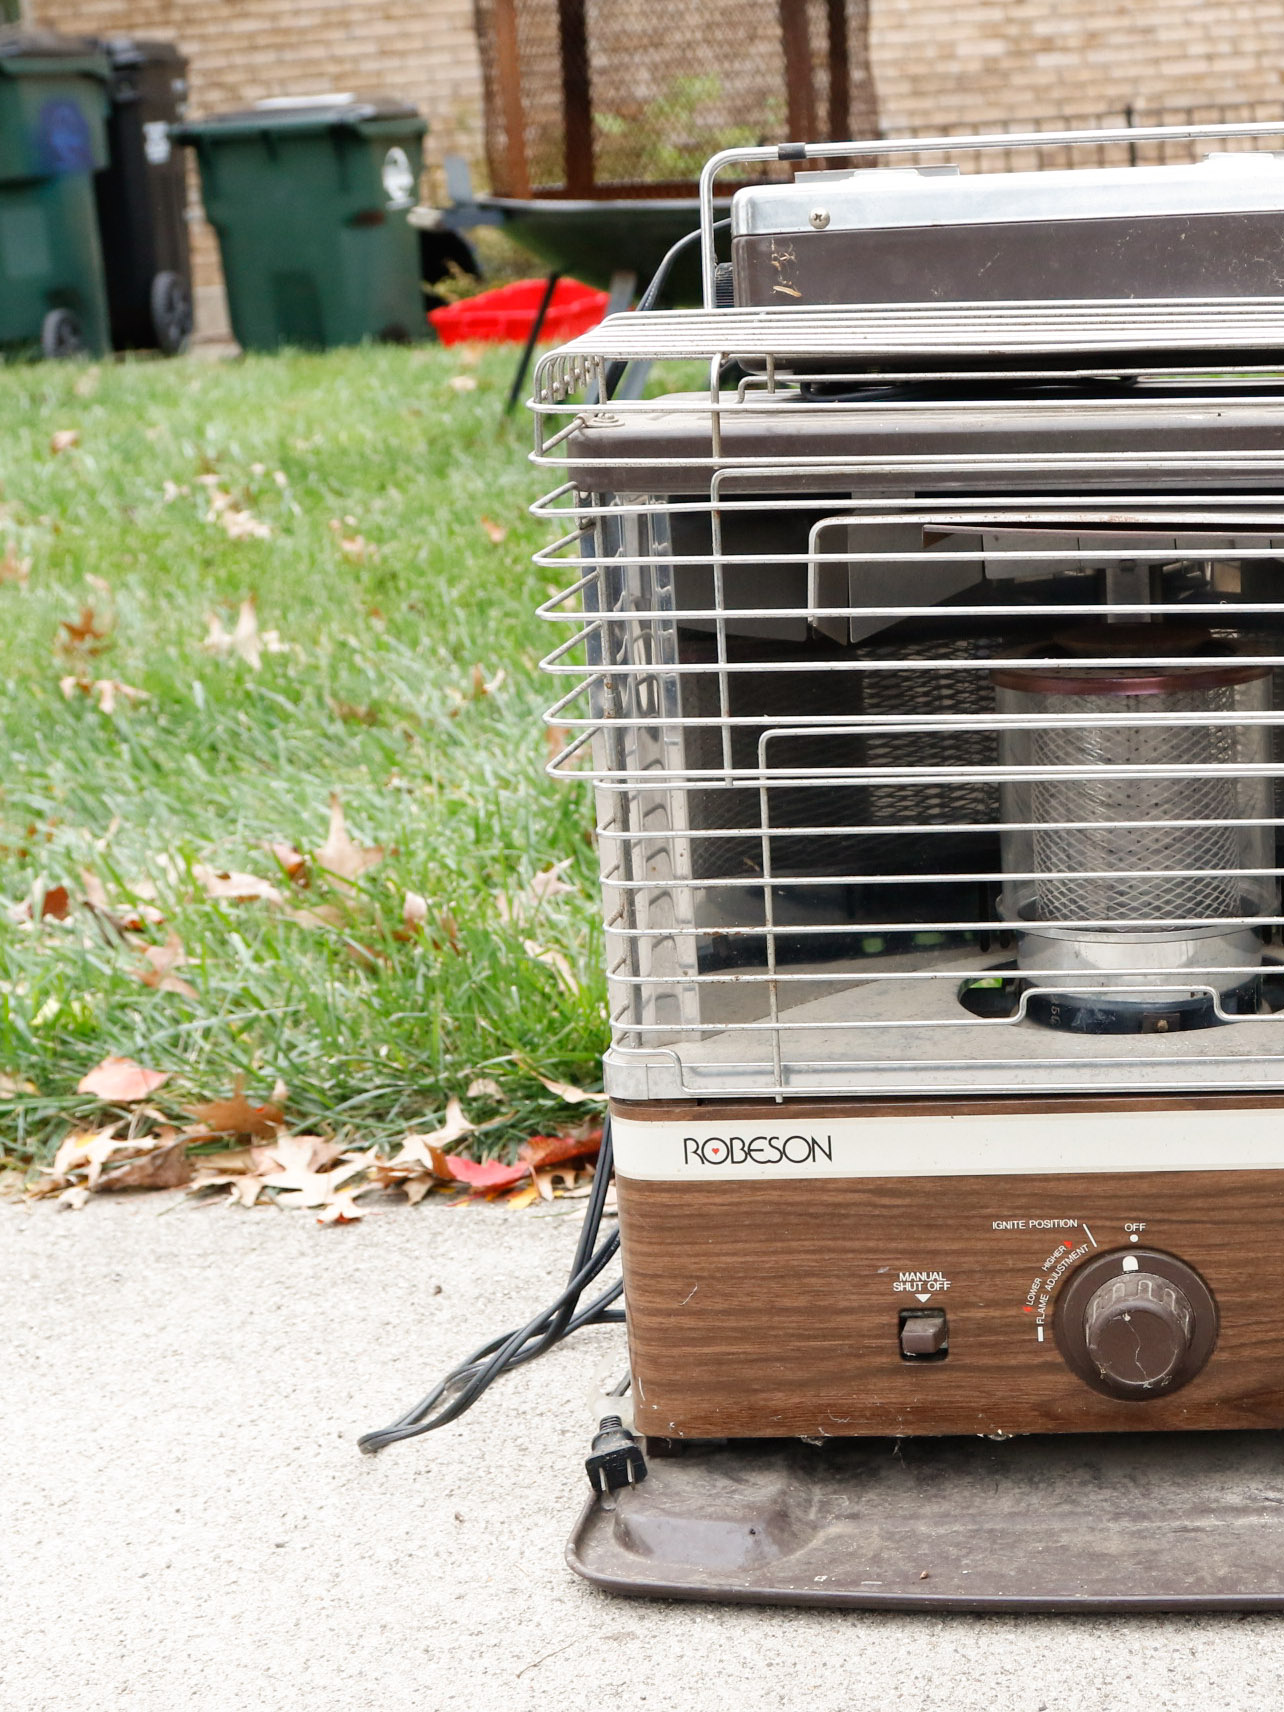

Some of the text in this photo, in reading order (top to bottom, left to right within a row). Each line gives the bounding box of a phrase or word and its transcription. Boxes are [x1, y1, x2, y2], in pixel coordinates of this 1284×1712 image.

[683, 1135, 833, 1165] ROBESON
[992, 1219, 1078, 1230] IGNITE POSITION
[1124, 1222, 1146, 1232] OFF
[899, 1272, 947, 1281] MANUAL
[1027, 1244, 1067, 1306] LOWER HIGHER
[893, 1281, 951, 1291] SHUT OFF
[1036, 1243, 1089, 1325] FLAME ADJUSTMENT
